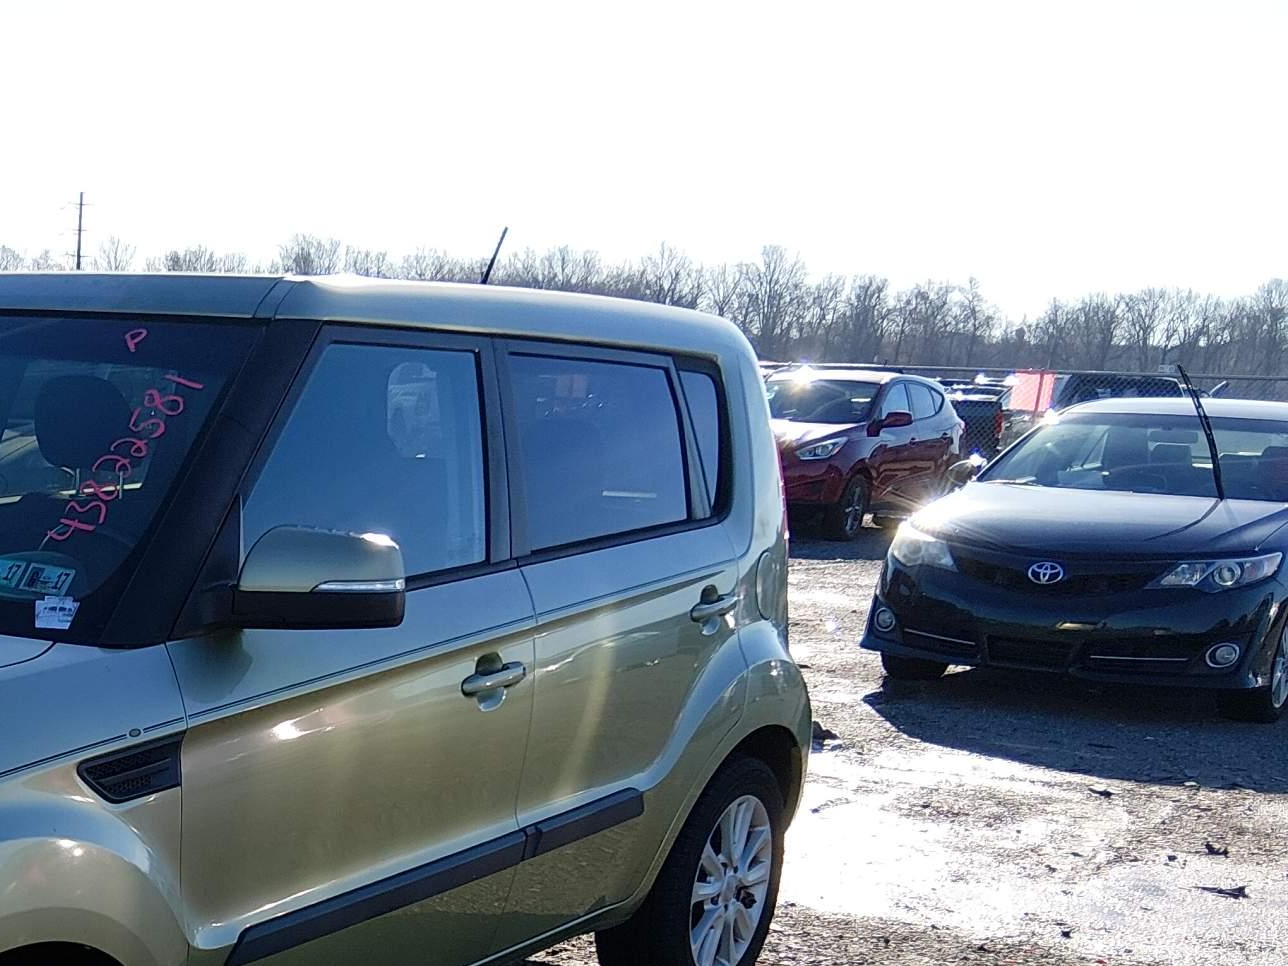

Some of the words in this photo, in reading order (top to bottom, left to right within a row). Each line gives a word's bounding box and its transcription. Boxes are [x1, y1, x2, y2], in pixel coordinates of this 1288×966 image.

[125, 328, 148, 352] P
[47, 373, 204, 541] 43822581
[2, 564, 23, 581] 17
[51, 572, 70, 591] 17
